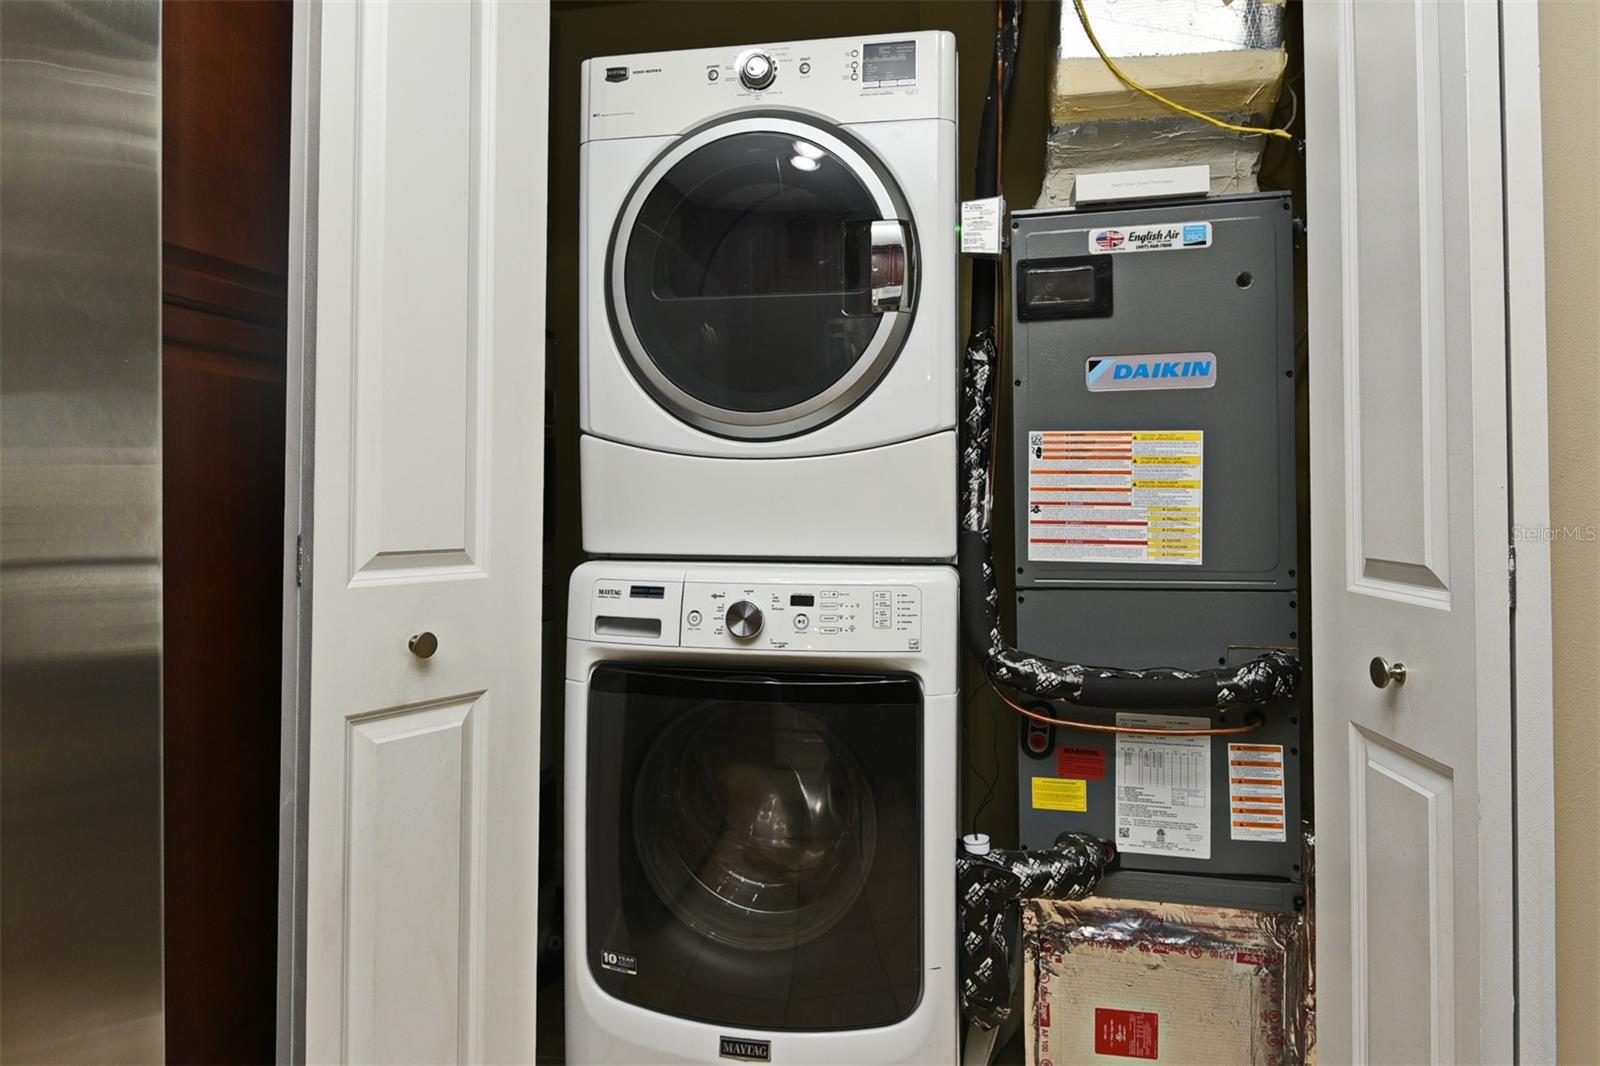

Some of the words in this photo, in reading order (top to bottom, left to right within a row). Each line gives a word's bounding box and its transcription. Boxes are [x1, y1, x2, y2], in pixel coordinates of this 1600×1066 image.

[1128, 230, 1163, 243] English
[1163, 229, 1180, 240] Air
[1113, 361, 1211, 380] DAIKIN
[597, 588, 622, 596] MAYTAG
[603, 952, 618, 964] 10
[723, 1041, 767, 1057] MAYTAG
[1041, 1041, 1050, 1053] 100
